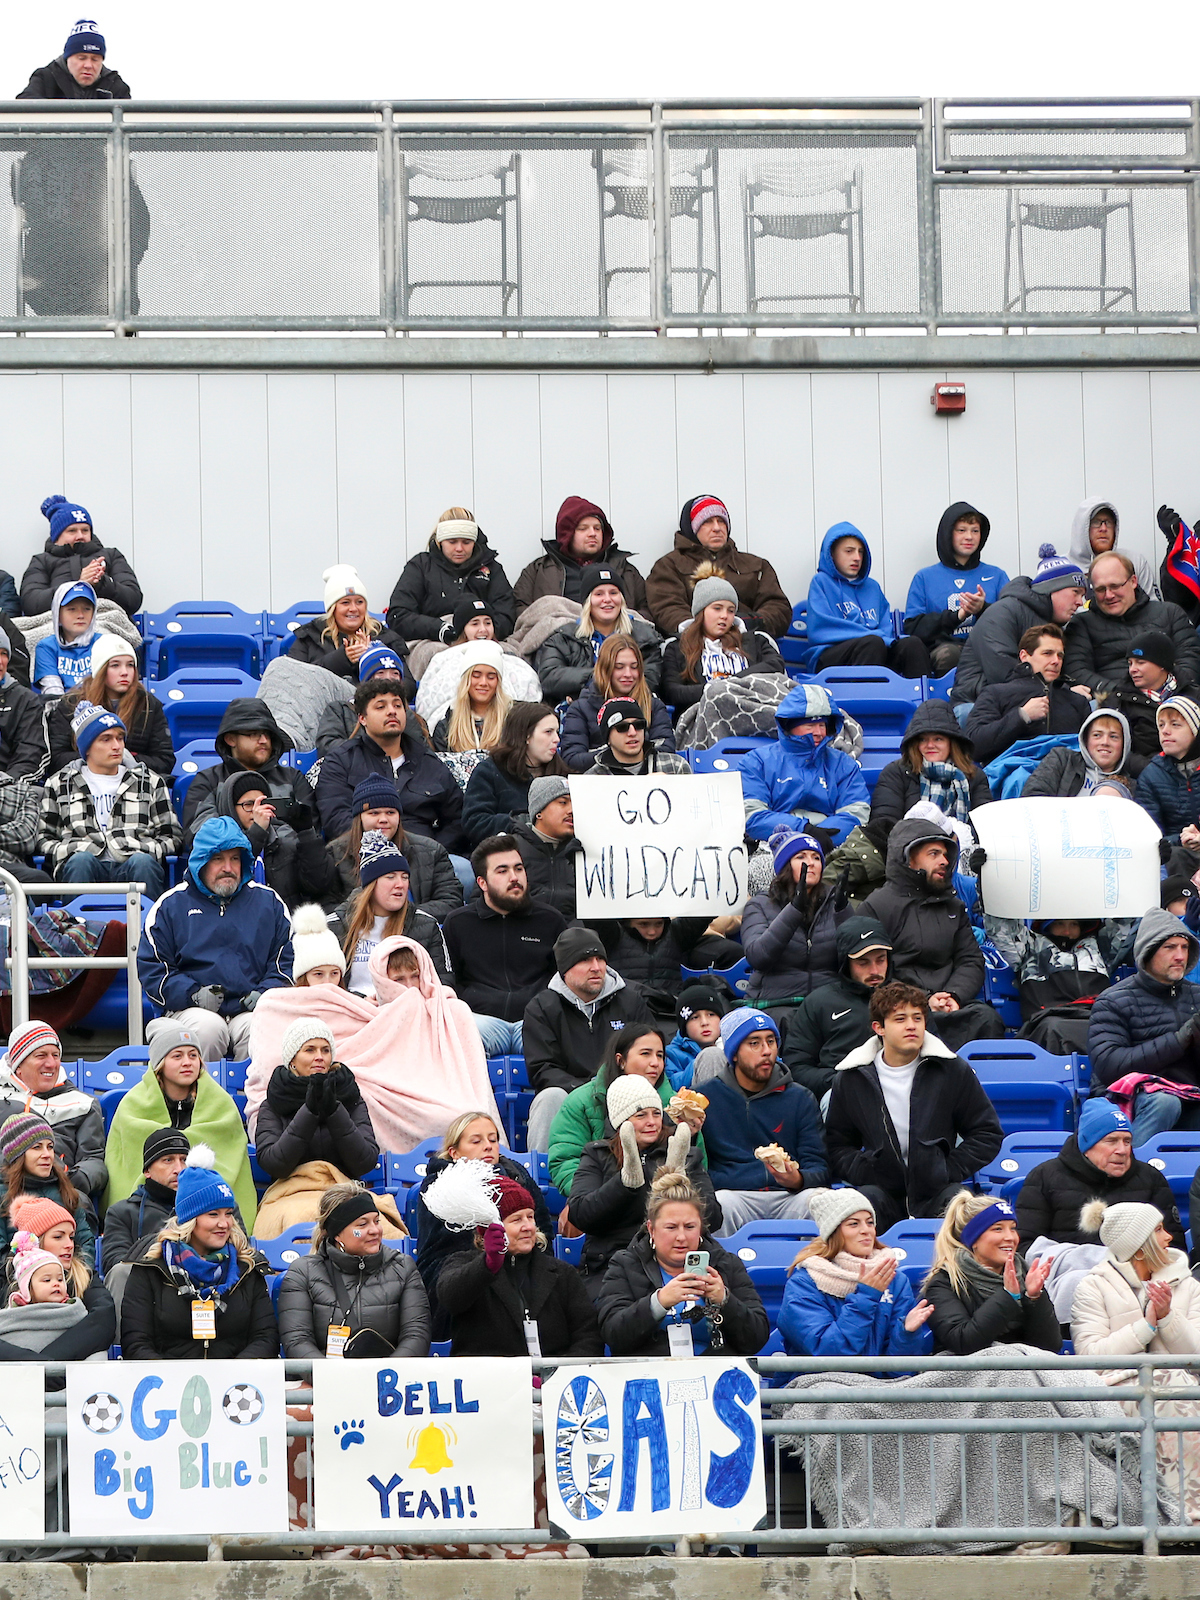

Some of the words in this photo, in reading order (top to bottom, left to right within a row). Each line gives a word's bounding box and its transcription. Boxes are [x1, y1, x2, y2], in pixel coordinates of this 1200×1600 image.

[617, 788, 672, 825] GO
[583, 845, 744, 907] WILDCATS
[131, 1374, 212, 1441] GO
[376, 1367, 480, 1417] BELL
[178, 1436, 269, 1489] Blue!
[556, 1368, 757, 1521] CATS
[94, 1448, 154, 1520] Big
[366, 1473, 478, 1519] YEAH!
